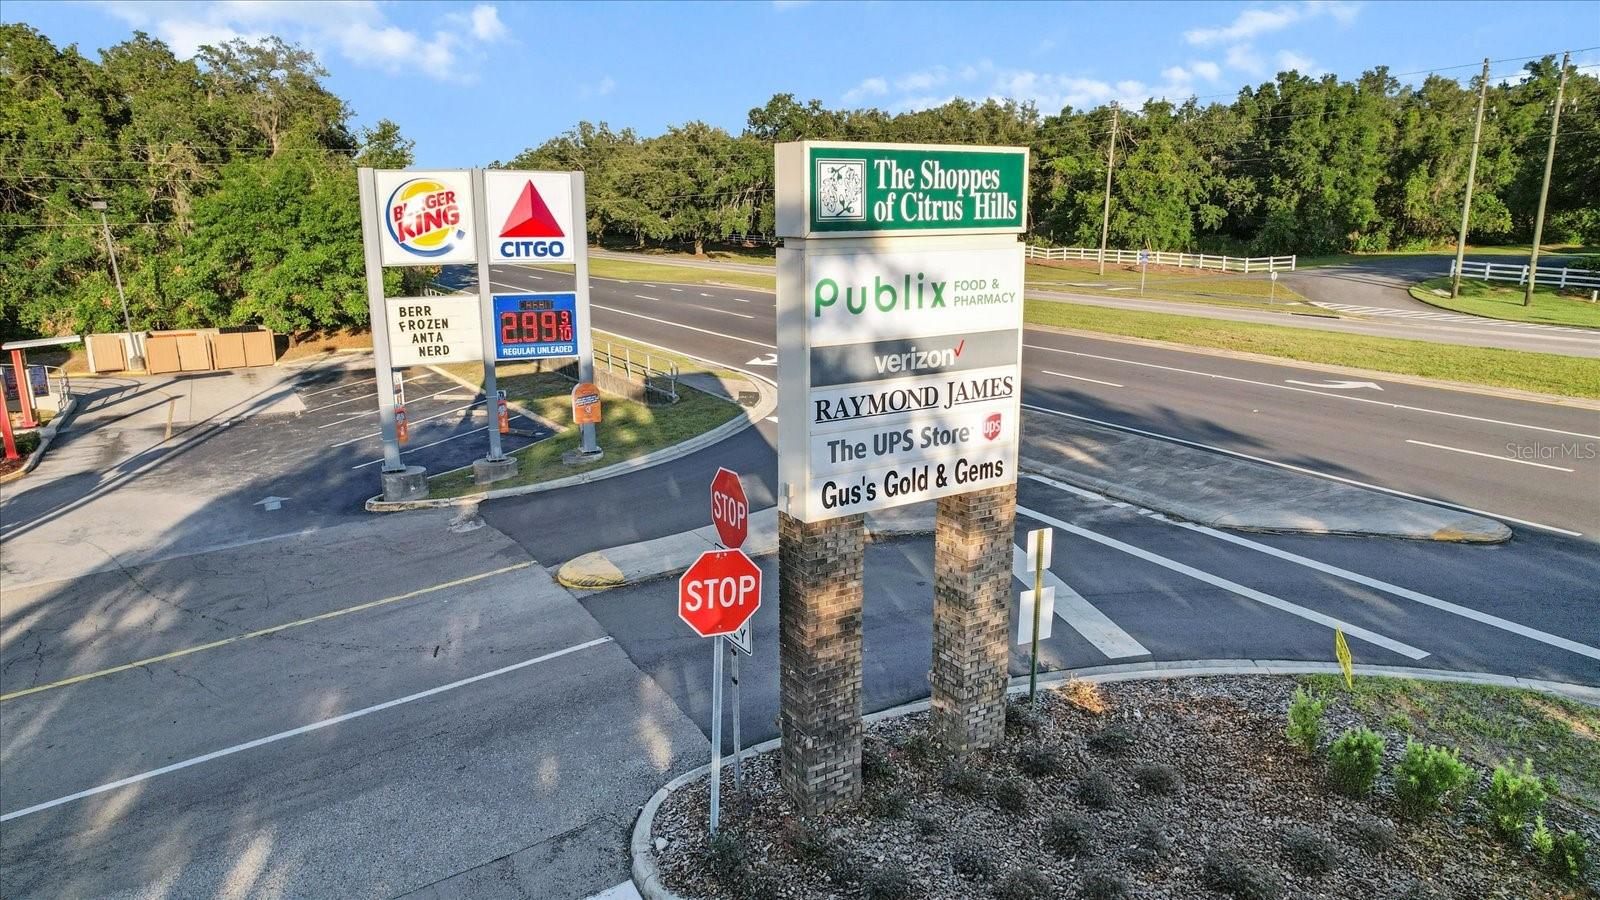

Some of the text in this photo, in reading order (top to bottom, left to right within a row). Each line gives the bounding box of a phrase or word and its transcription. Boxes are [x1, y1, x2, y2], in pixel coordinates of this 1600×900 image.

[874, 159, 1000, 197] The Shoppes
[393, 191, 456, 222] BGER
[874, 192, 1017, 222] of Citrus Hills
[398, 205, 459, 242] KING
[501, 241, 564, 258] CITGO
[814, 272, 947, 317] Publix
[954, 279, 1000, 291] FOOD &
[954, 292, 1016, 306] PHARMACY
[399, 306, 431, 317] BERR
[399, 318, 449, 332] FROZEN
[412, 332, 443, 343] ANTA
[419, 345, 450, 357] NERD
[503, 345, 573, 356] REGULAR UNLEADED
[874, 347, 955, 373] verizon
[815, 376, 1013, 421] RAYMOND JAMES
[827, 425, 969, 464] The UPS Store
[821, 458, 1003, 509] Gus's Gold & Gems
[714, 490, 746, 530] STOP
[685, 575, 756, 612] STOP
